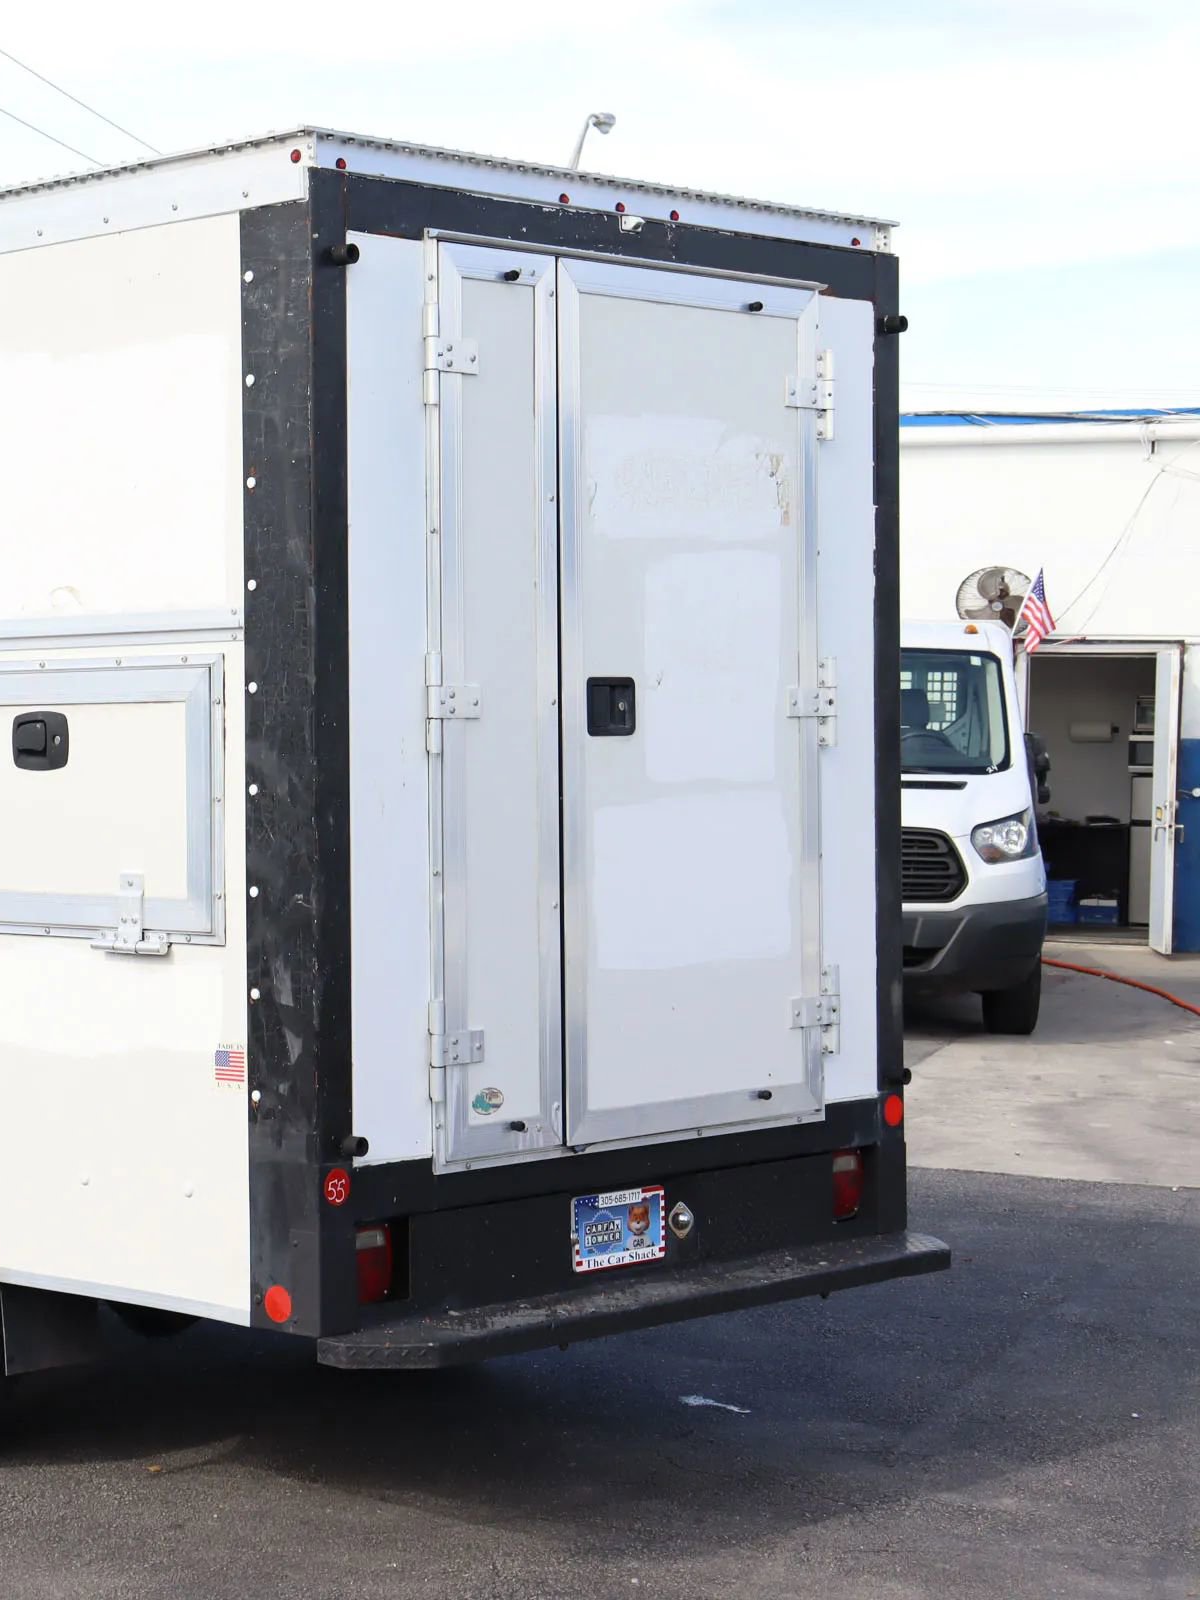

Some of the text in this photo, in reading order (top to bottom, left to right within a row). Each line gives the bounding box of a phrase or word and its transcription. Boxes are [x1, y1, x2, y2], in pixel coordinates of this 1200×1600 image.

[328, 1179, 345, 1203] 55
[600, 1192, 640, 1206] 305-685-1717
[585, 1220, 620, 1234] CARFAX
[591, 1232, 620, 1245] OWNER
[632, 1238, 645, 1248] CAR
[586, 1248, 657, 1269] The Car Shack
